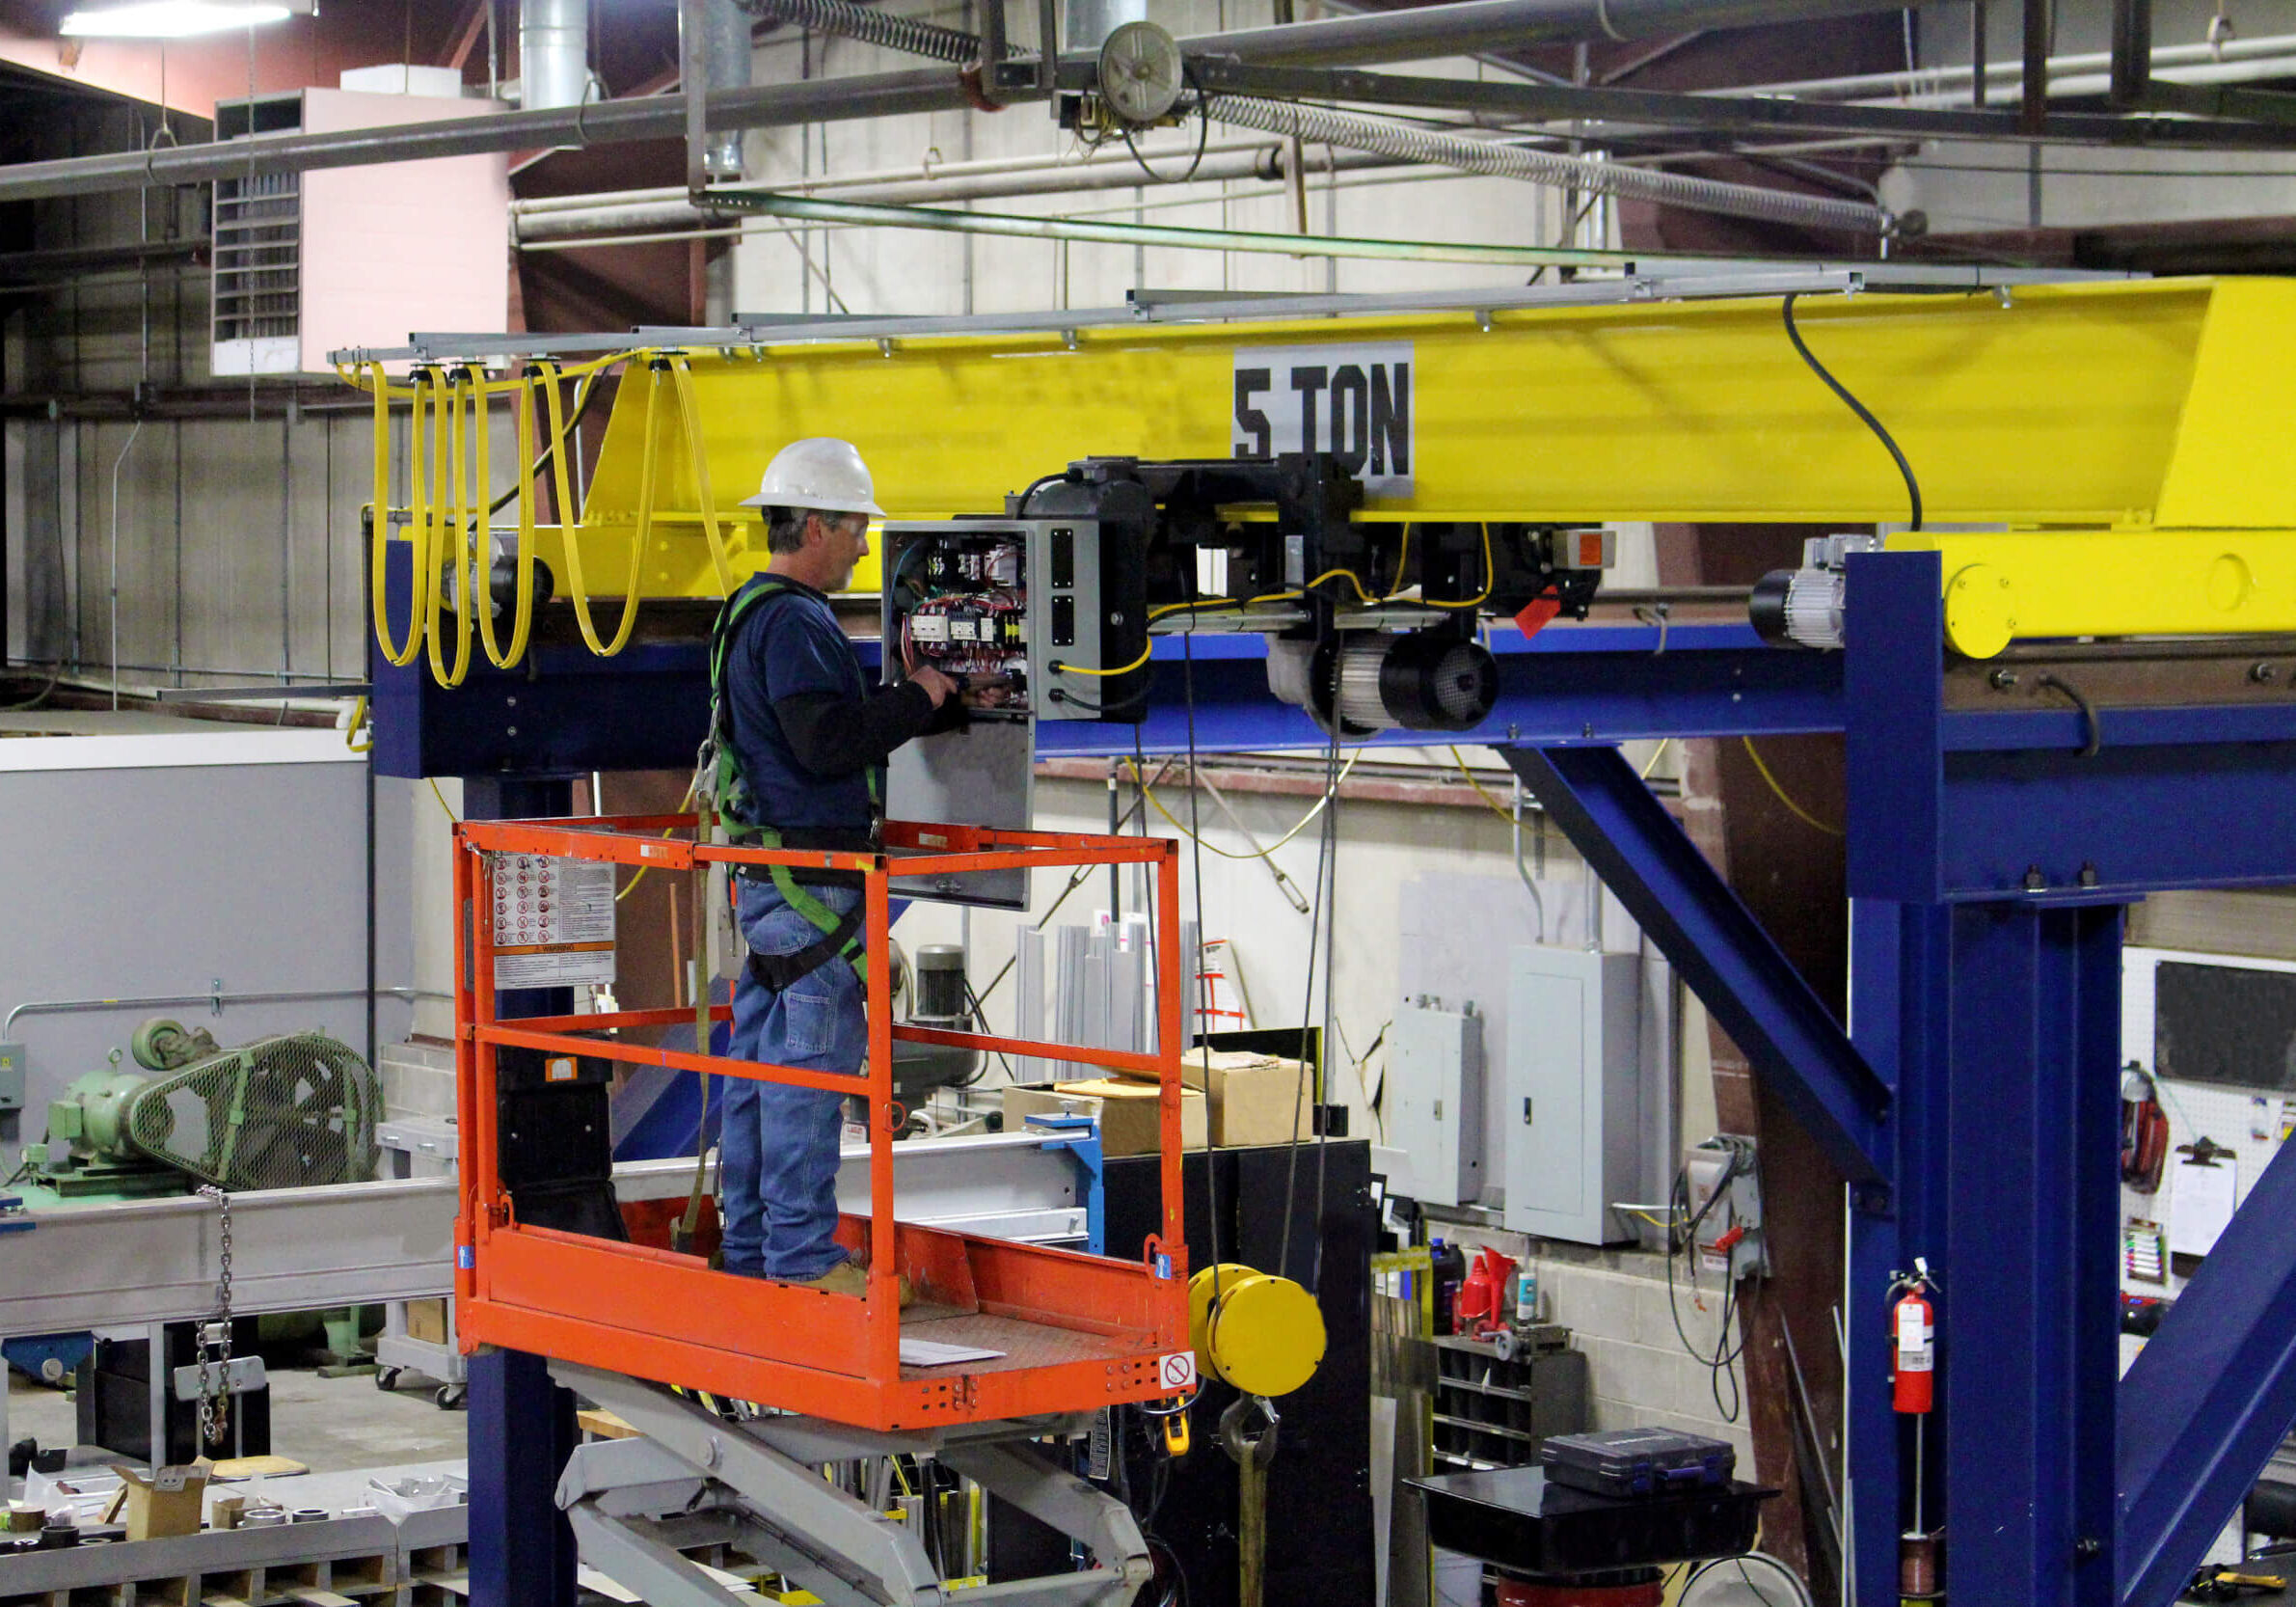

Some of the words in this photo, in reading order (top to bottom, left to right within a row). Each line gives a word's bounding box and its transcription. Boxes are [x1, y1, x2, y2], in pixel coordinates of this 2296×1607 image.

[1235, 368, 1271, 459] 5
[1291, 363, 1409, 476] TON
[542, 943, 576, 952] WARNING
